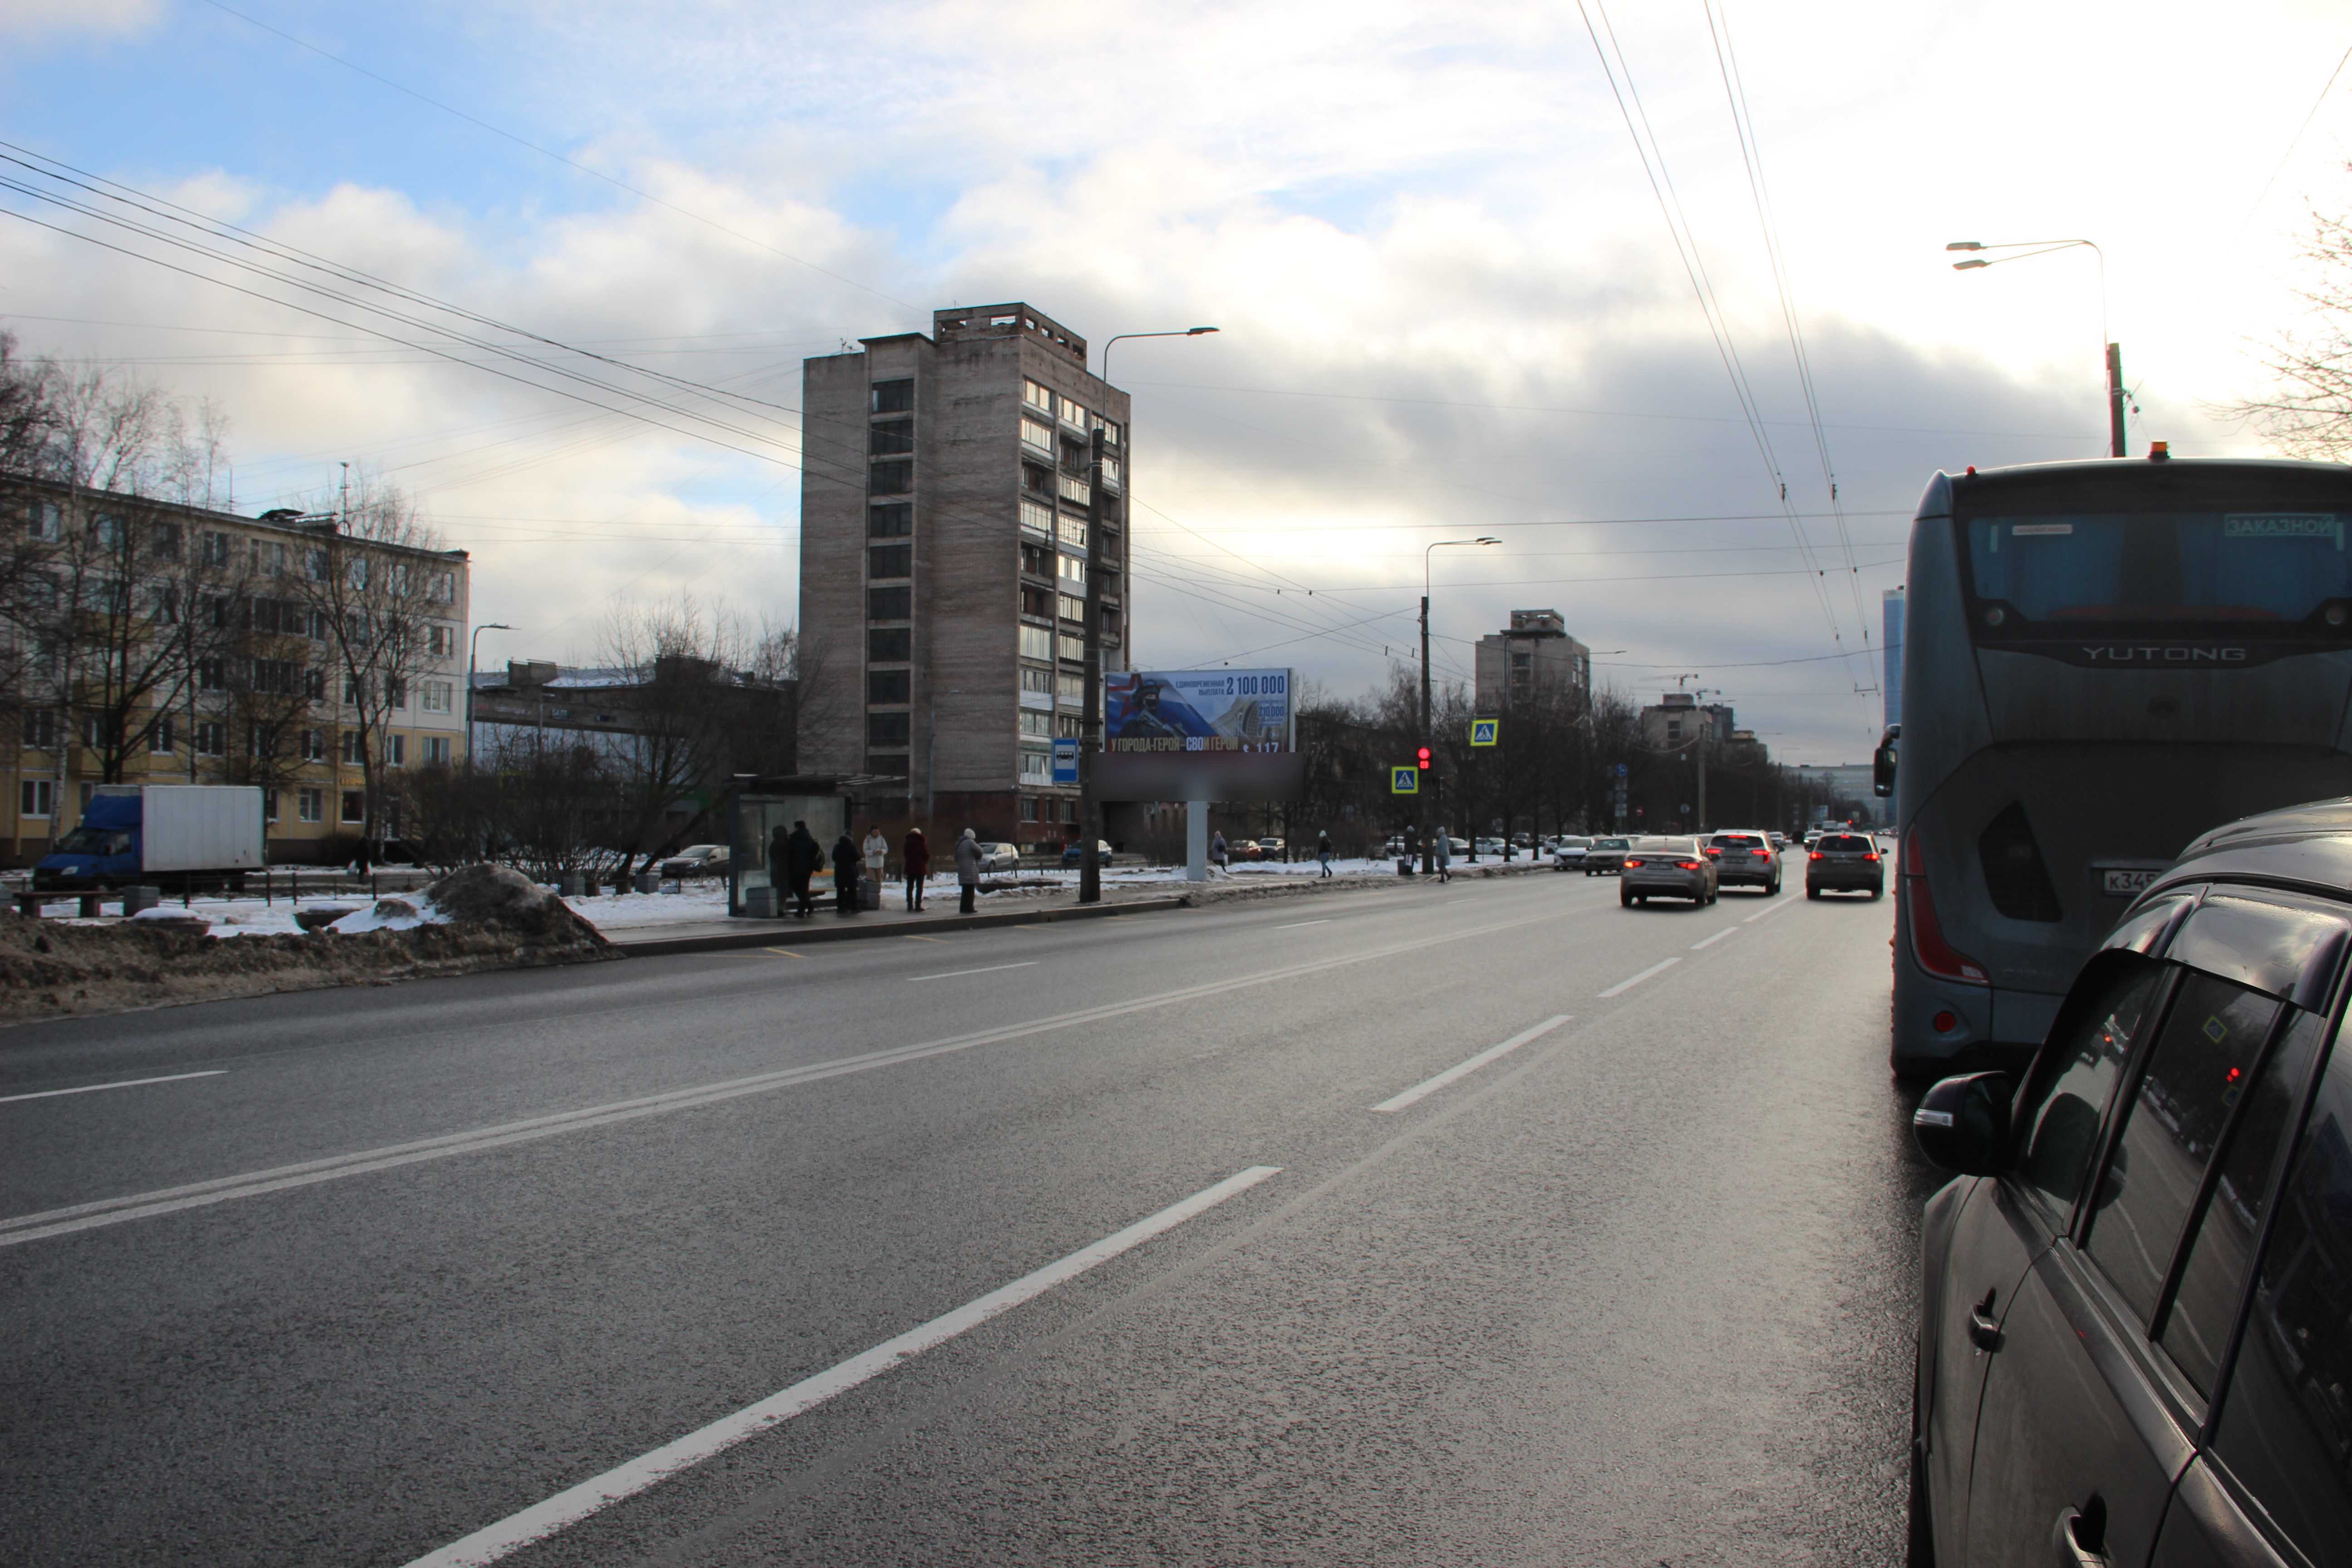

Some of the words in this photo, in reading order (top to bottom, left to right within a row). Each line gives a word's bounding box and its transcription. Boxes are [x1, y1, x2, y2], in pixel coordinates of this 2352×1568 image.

[2228, 515, 2334, 534] ЗАКАЗНОЙ
[2082, 647, 2247, 661] YUTONG
[1226, 677, 1234, 695] 2
[1237, 676, 1258, 695] 100
[1261, 676, 1284, 694] 000
[1111, 737, 1117, 752] У
[1118, 737, 1180, 752] ГОРОДА-ГЕРОЯ
[1186, 736, 1210, 751] СВОИ
[1256, 742, 1279, 753] 117
